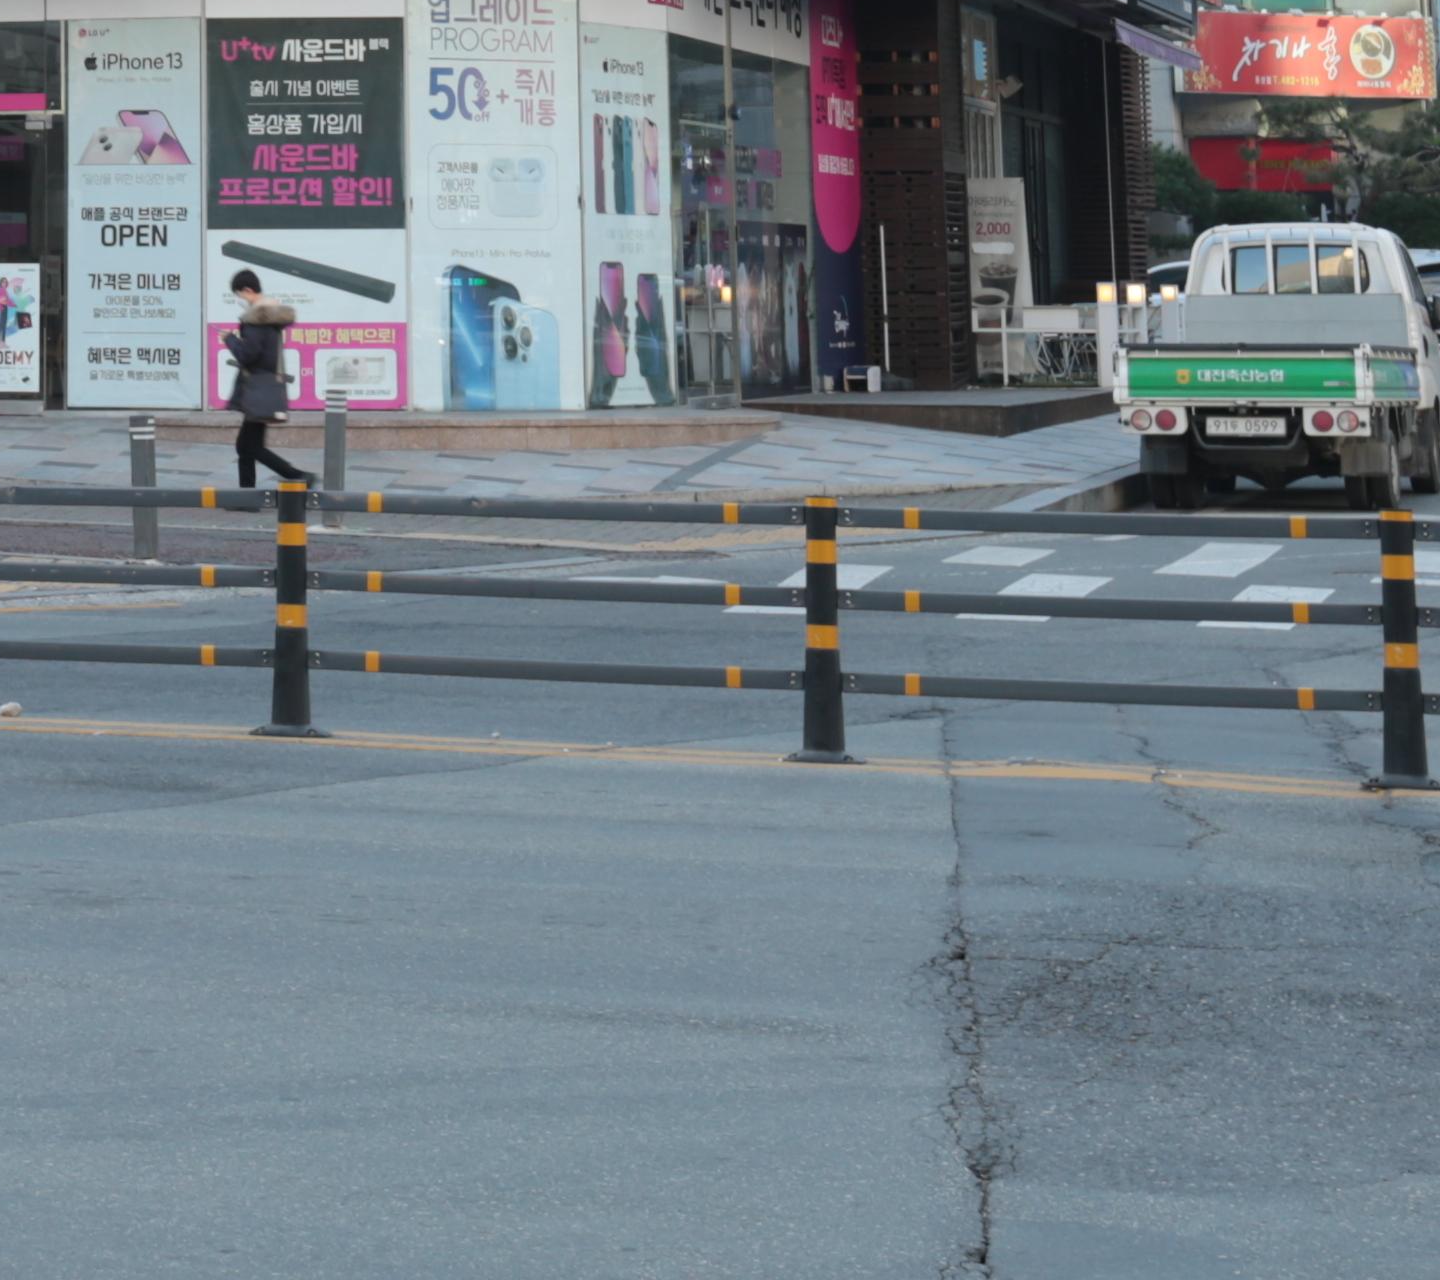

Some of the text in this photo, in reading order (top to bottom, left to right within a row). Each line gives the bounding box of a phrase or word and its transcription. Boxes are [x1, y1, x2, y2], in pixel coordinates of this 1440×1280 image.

[281, 38, 365, 62] 사운드바
[430, 28, 553, 53] PROGRAM
[102, 52, 184, 71] iPhone 13
[250, 79, 360, 97] 출시 기념 이벤트
[514, 69, 555, 97] 즉시
[515, 100, 556, 127] 개통
[247, 114, 362, 136] 홈상품 가입시
[253, 144, 359, 173] 사운드바
[218, 178, 323, 208] 프로모션
[332, 177, 393, 208] 할인!
[81, 207, 105, 222] 애플
[109, 207, 134, 222] 공식
[101, 225, 168, 248] OPEN
[976, 222, 1010, 237] 2,000
[88, 273, 181, 291] 가격은 미니멈
[88, 347, 181, 365] 혜택은 맥시멈
[1197, 369, 1284, 383] 대전축산농협
[1244, 419, 1278, 432] 0599
